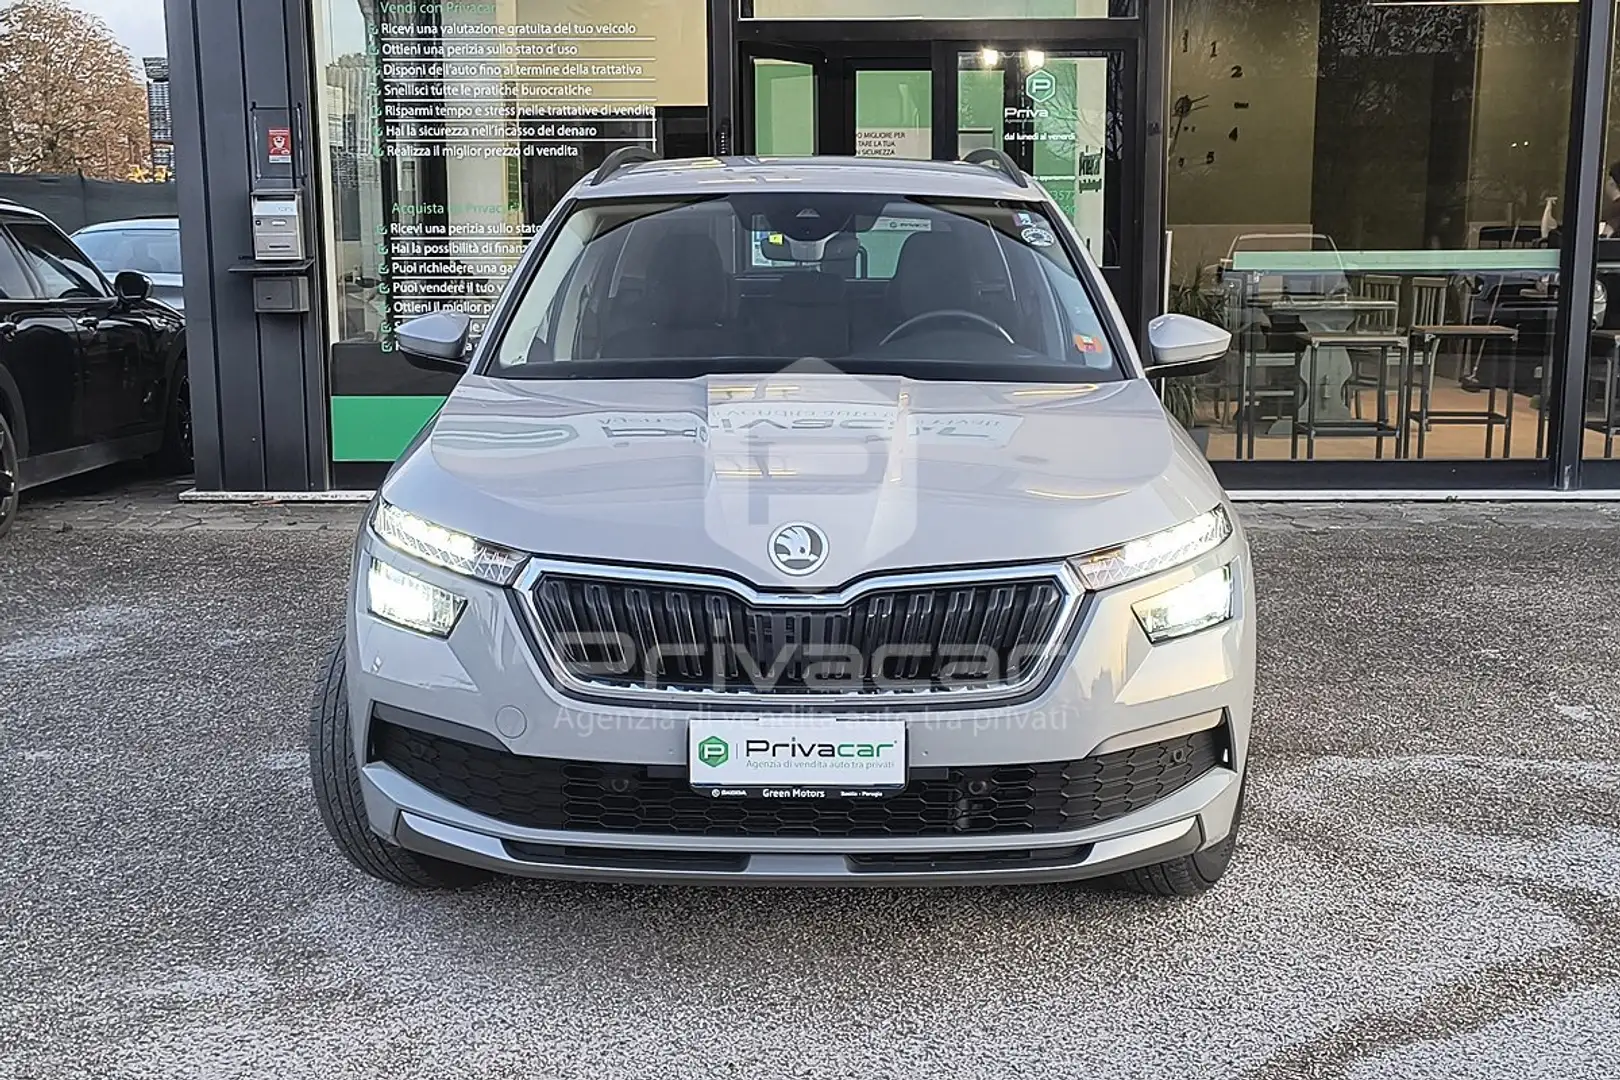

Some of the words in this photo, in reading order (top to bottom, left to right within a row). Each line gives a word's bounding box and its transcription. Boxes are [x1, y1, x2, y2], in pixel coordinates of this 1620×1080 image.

[380, 2, 416, 13] Vendi
[420, 4, 442, 13] con
[446, 2, 496, 14] Privacar
[381, 23, 414, 34] Ricevi
[417, 25, 438, 34] una
[441, 23, 505, 34] valutazione
[507, 22, 551, 36] gratuita
[553, 22, 571, 34] del
[574, 24, 593, 34] tuo
[595, 22, 636, 34] veicolo
[382, 43, 421, 55] Ottieni
[423, 46, 444, 55] una
[447, 43, 484, 58] perizia
[487, 43, 513, 55] sullo
[515, 45, 543, 54] stato
[383, 64, 426, 78] Disponi
[480, 64, 501, 76] fino
[503, 64, 513, 75] al
[516, 64, 560, 75] termine
[562, 64, 589, 75] della
[591, 64, 643, 75] trattativa
[1231, 65, 1243, 78] 2
[384, 84, 428, 96] Snellisci
[431, 84, 459, 96] tutte
[461, 84, 471, 96] le
[473, 84, 519, 98] pratiche
[521, 84, 593, 96] burocratiche
[385, 105, 433, 118] Risparmi
[435, 106, 473, 118] tempo
[474, 107, 482, 116] e
[484, 106, 515, 116] stress
[517, 104, 545, 116] nelle
[547, 105, 599, 116] trattative
[600, 104, 612, 116] di
[613, 104, 655, 116] vendita
[386, 125, 405, 136] Hai
[407, 125, 417, 136] la
[418, 125, 469, 136] sicurezza
[537, 125, 555, 136] del
[557, 125, 597, 136] denaro
[387, 145, 431, 156] Realizza
[433, 145, 440, 156] il
[442, 145, 481, 159] miglior
[484, 147, 521, 159] prezzo
[523, 145, 535, 156] di
[536, 145, 579, 156] vendita
[392, 203, 444, 216] Acquista
[390, 223, 422, 234] Ricevi
[425, 225, 446, 234] una
[449, 223, 485, 236] perizia
[487, 223, 513, 234] sullo
[391, 243, 410, 254] Hai
[411, 243, 421, 254] la
[481, 243, 492, 254] di
[392, 263, 417, 274] Puoi
[419, 262, 474, 274] richiedere
[476, 264, 497, 274] una
[393, 282, 417, 293] Puoi
[420, 282, 465, 293] vendere
[467, 282, 474, 293] il
[475, 283, 495, 293] tuo
[393, 302, 431, 312] Ottieni
[746, 737, 895, 758] Privacar
[746, 761, 782, 769] Agenzia
[783, 760, 792, 768] di
[795, 760, 827, 768] vendita
[866, 761, 895, 769] privati
[762, 788, 790, 798] Green
[792, 788, 826, 798] Motors
